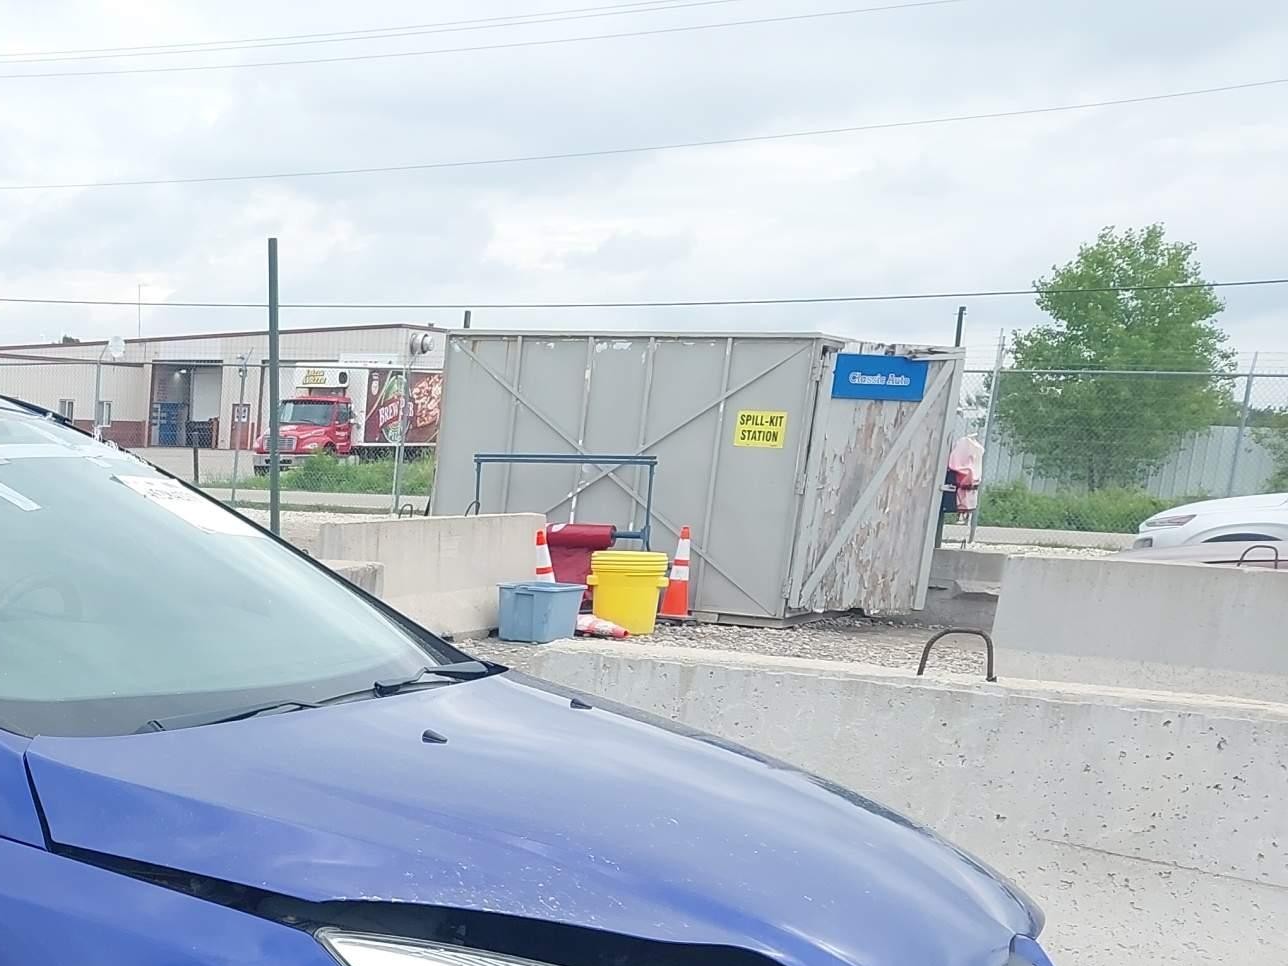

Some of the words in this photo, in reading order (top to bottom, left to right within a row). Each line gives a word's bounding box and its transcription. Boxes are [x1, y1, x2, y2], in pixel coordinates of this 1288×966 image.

[848, 371, 886, 385] Classic
[886, 373, 911, 386] Auto
[739, 414, 784, 427] SPILL-KIT
[740, 429, 778, 442] STATION
